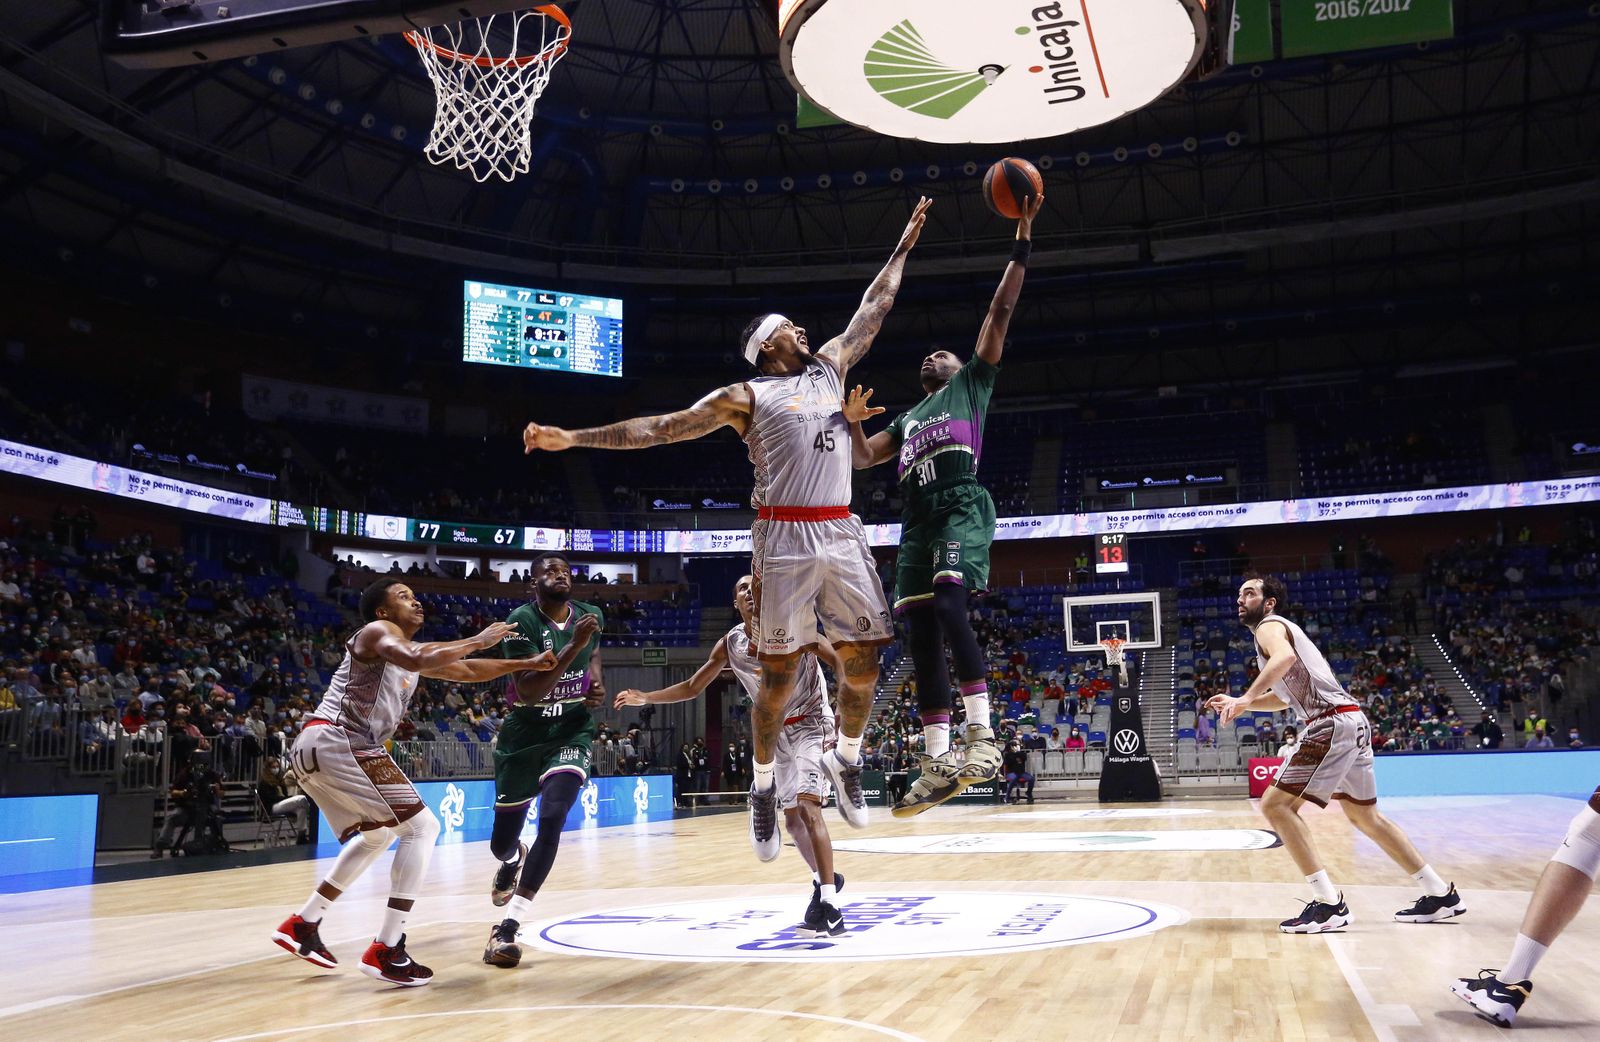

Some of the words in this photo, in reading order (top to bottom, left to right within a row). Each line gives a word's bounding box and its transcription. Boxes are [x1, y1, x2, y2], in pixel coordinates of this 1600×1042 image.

[1315, 0, 1411, 21] 2016/2017
[1016, 1, 1087, 105] Unicaja
[517, 290, 532, 302] 77
[559, 296, 574, 307] 67
[538, 311, 552, 321] 4T
[534, 328, 561, 342] 9:17
[917, 411, 951, 430] Unicaja
[813, 429, 836, 453] 45
[4, 447, 22, 458] con
[25, 451, 45, 463] más
[47, 455, 59, 466] de
[916, 459, 937, 487] 30
[128, 474, 140, 484] No
[142, 478, 151, 486] se
[153, 481, 184, 495] permite
[185, 488, 211, 499] acceso
[212, 494, 225, 503] con
[226, 495, 243, 506] más
[244, 499, 254, 509] de
[1544, 484, 1558, 492] No
[1318, 501, 1331, 509] No
[1332, 500, 1342, 508] se
[1344, 498, 1381, 508] permite
[1383, 495, 1414, 504] acceso
[1415, 493, 1433, 502] con
[1435, 490, 1453, 500] más
[1456, 490, 1469, 499] de
[1132, 511, 1166, 522] permite
[1167, 510, 1196, 519] acceso
[1198, 508, 1215, 517] con
[1216, 506, 1235, 516] más
[1236, 506, 1248, 514] de
[419, 523, 440, 539] 77
[1012, 520, 1029, 528] más
[1031, 519, 1042, 527] de
[453, 529, 465, 537] liga
[494, 528, 516, 545] 67
[1102, 534, 1124, 544] 9:17
[1099, 547, 1123, 563] 13
[764, 636, 795, 645] LEXUS
[1130, 755, 1150, 763] Wagen
[967, 786, 994, 794] Banco
[893, 912, 961, 925] LAS
[986, 903, 1070, 937] AUTOPISTA
